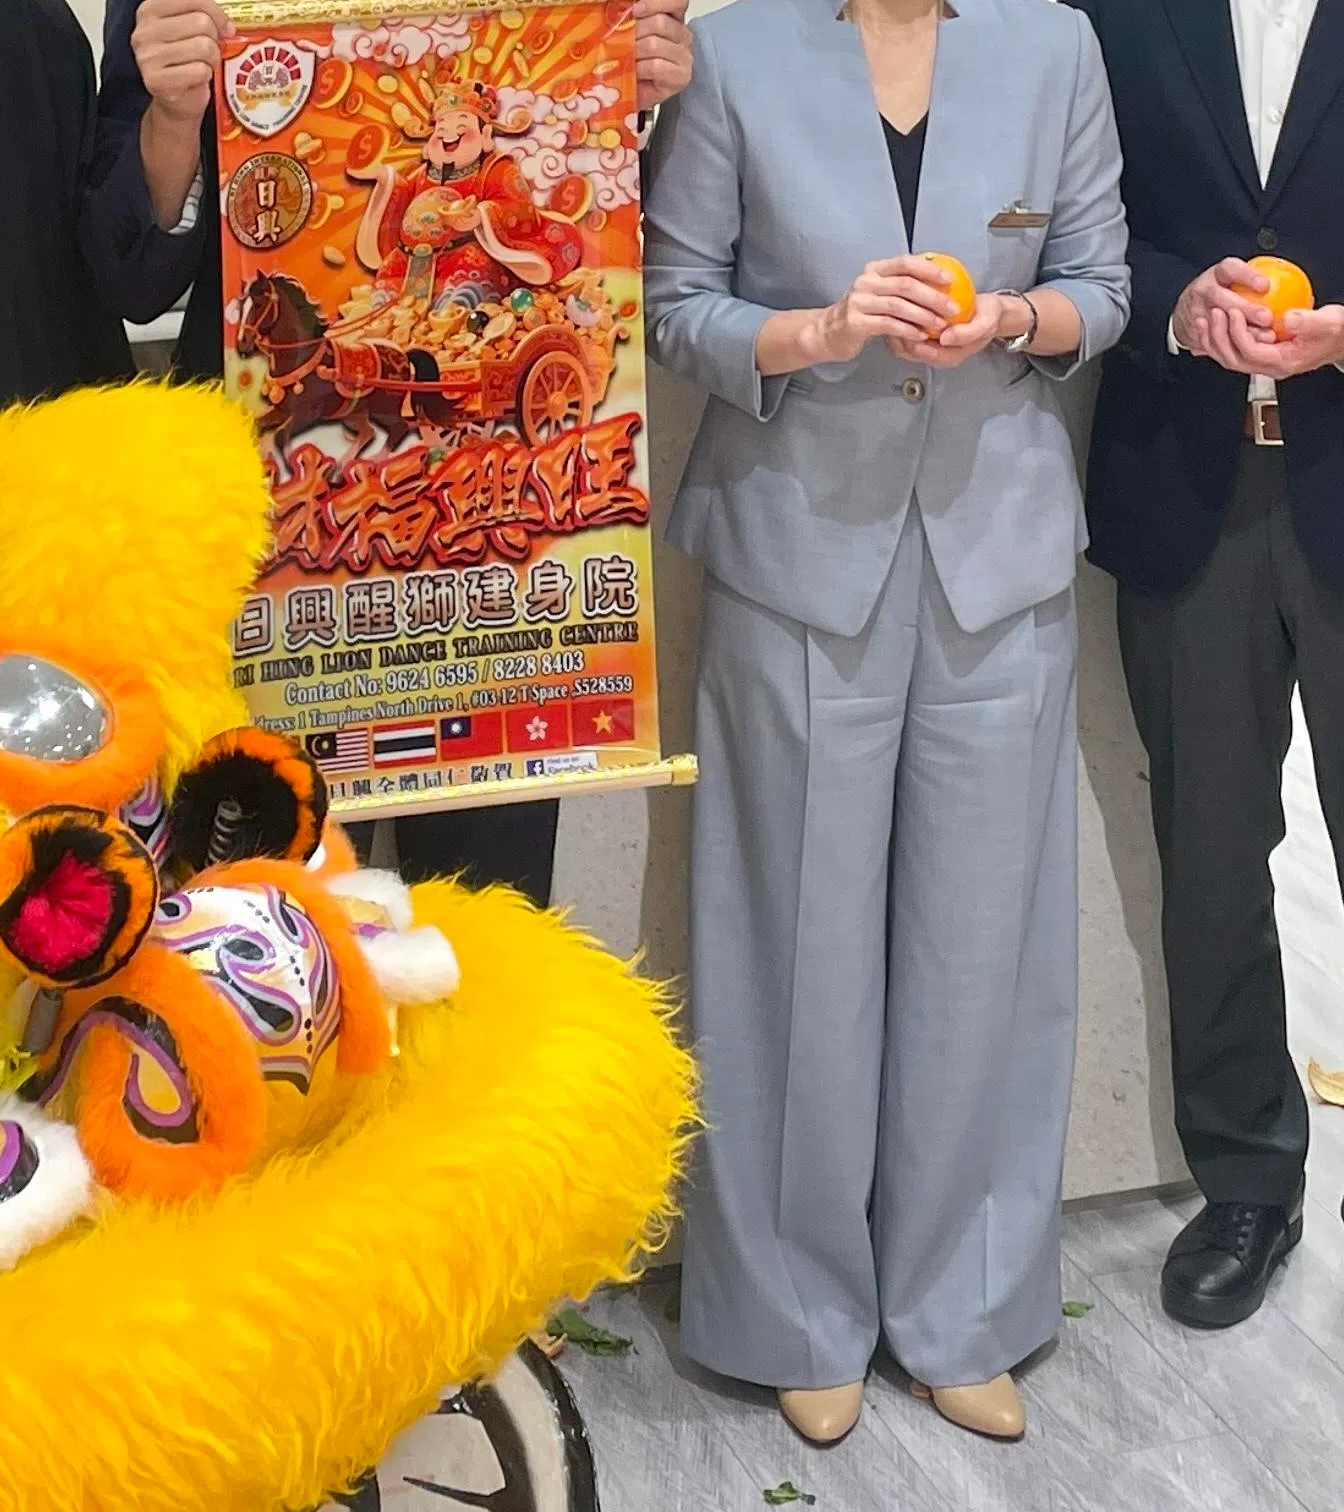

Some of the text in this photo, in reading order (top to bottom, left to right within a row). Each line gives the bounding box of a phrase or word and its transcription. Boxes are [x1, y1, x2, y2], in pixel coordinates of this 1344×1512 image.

[233, 555, 639, 657] 日興醒獅建身院
[261, 656, 314, 682] HING
[321, 648, 372, 675] LION
[379, 639, 447, 666] DANCE
[454, 628, 552, 658] TRAINING
[560, 621, 639, 646] CENTRE
[285, 649, 585, 706] Contact No: 9624 6595 / 8228 8403
[309, 704, 374, 729] Tampines
[375, 697, 415, 718] North
[416, 694, 454, 713] Drive
[531, 682, 568, 706] Space
